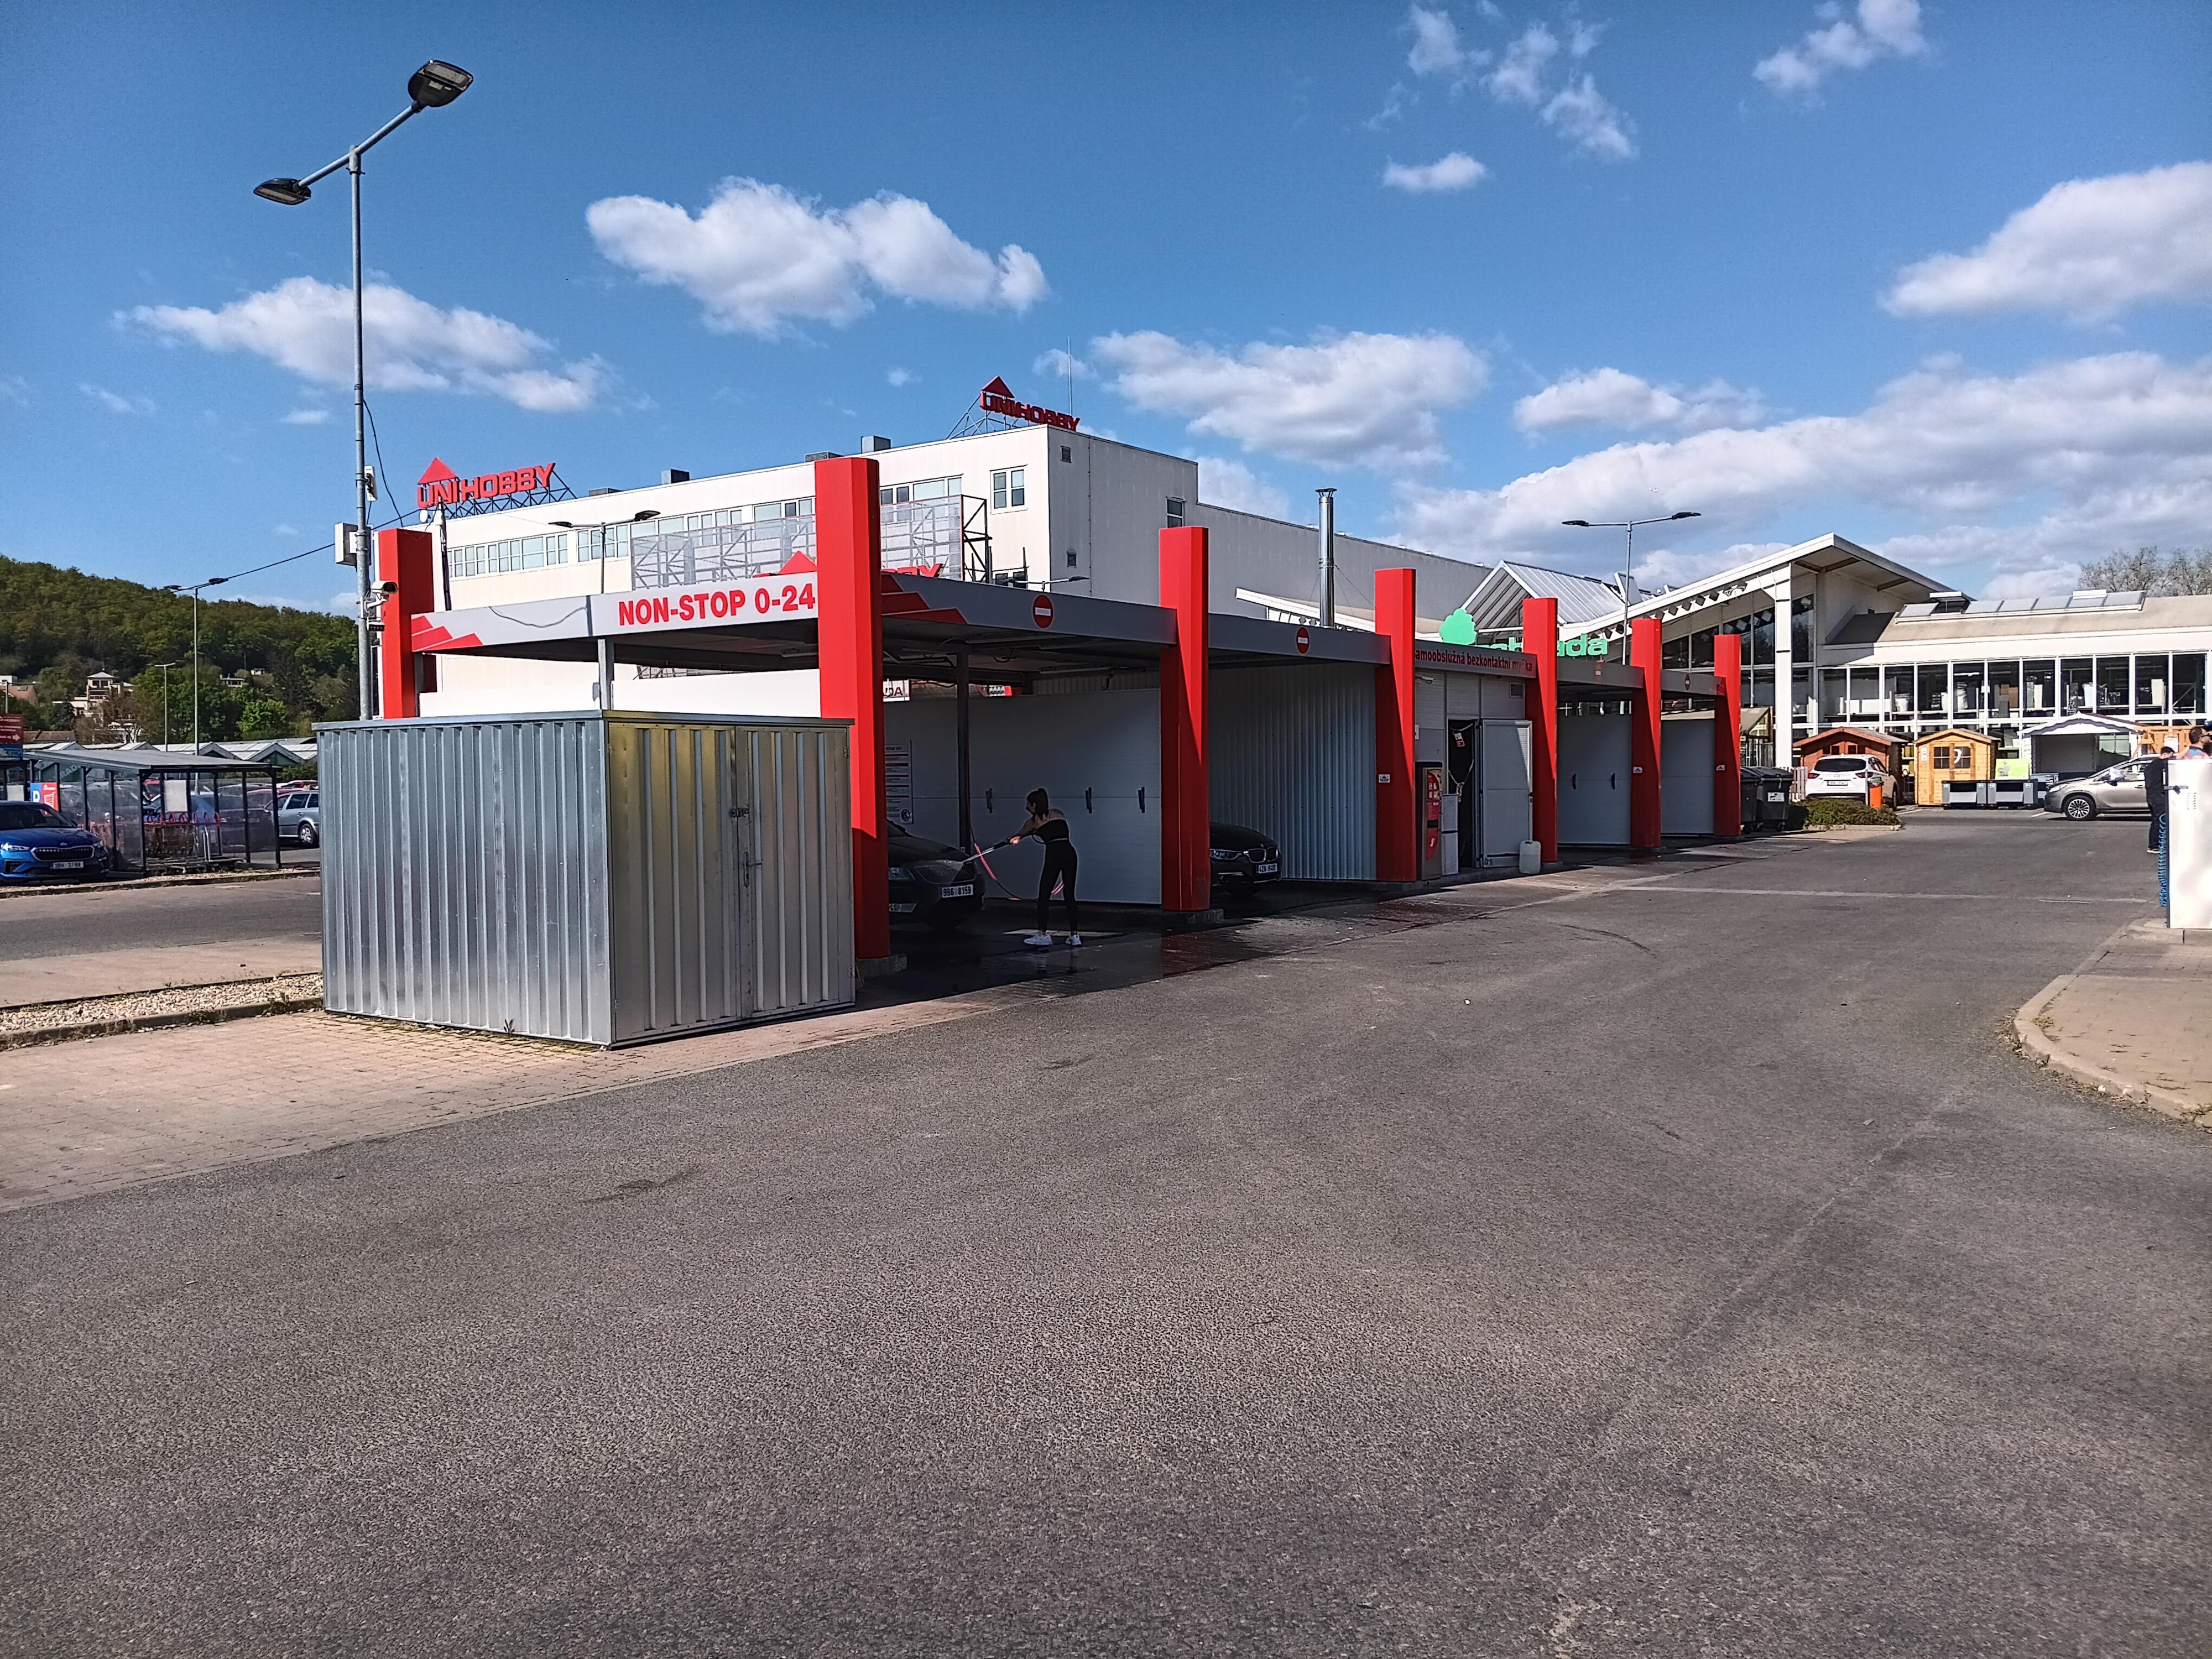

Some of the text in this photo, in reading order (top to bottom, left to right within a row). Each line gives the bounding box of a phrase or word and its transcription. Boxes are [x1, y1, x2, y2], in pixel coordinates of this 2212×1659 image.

[980, 390, 1081, 432] UNIHOBBY
[418, 462, 556, 509] UNIHOBBY
[619, 583, 816, 626] NON-STOP 0-24
[1415, 649, 1465, 664] amoobslužná
[1467, 653, 1511, 670] bezkontaktní
